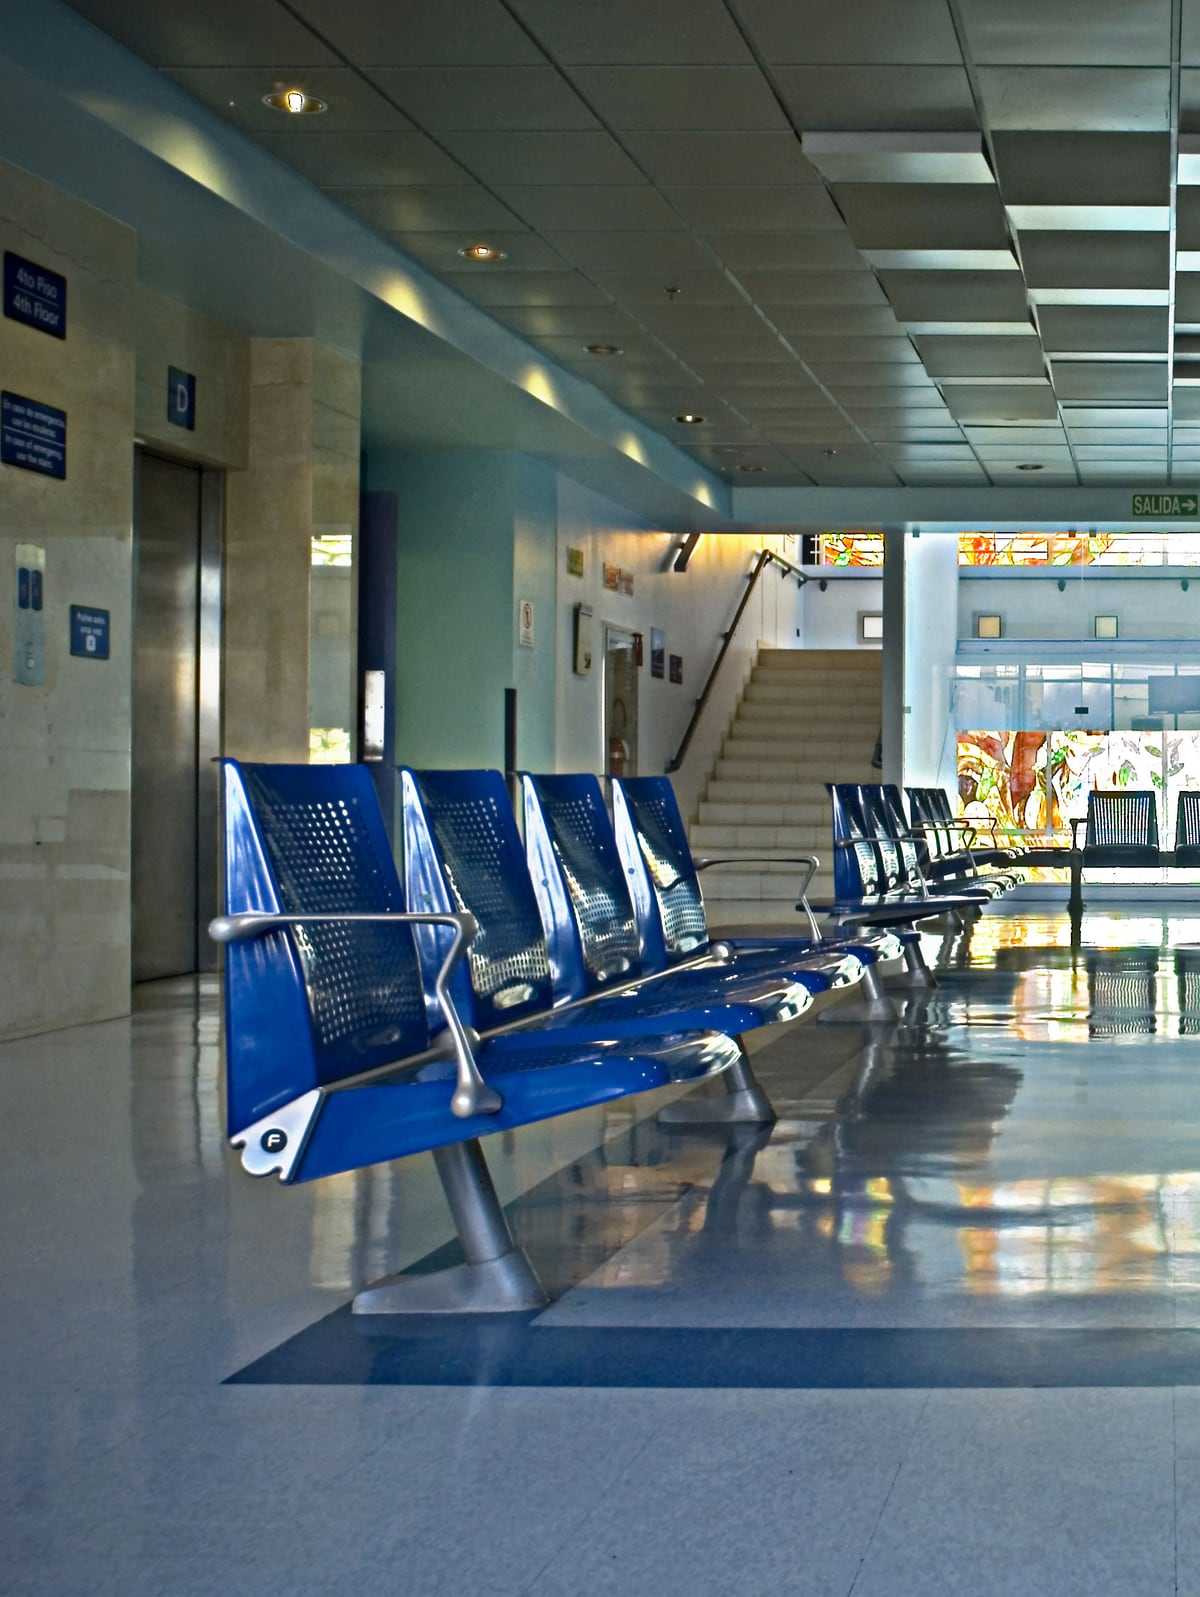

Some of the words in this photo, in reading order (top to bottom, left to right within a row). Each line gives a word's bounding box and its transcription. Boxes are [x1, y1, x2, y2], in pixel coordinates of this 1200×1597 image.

[16, 268, 34, 289] 4to
[13, 294, 33, 315] 4th
[34, 302, 59, 326] Floor
[177, 384, 188, 412] D
[1134, 496, 1181, 514] SALIDA
[267, 1134, 280, 1147] F
